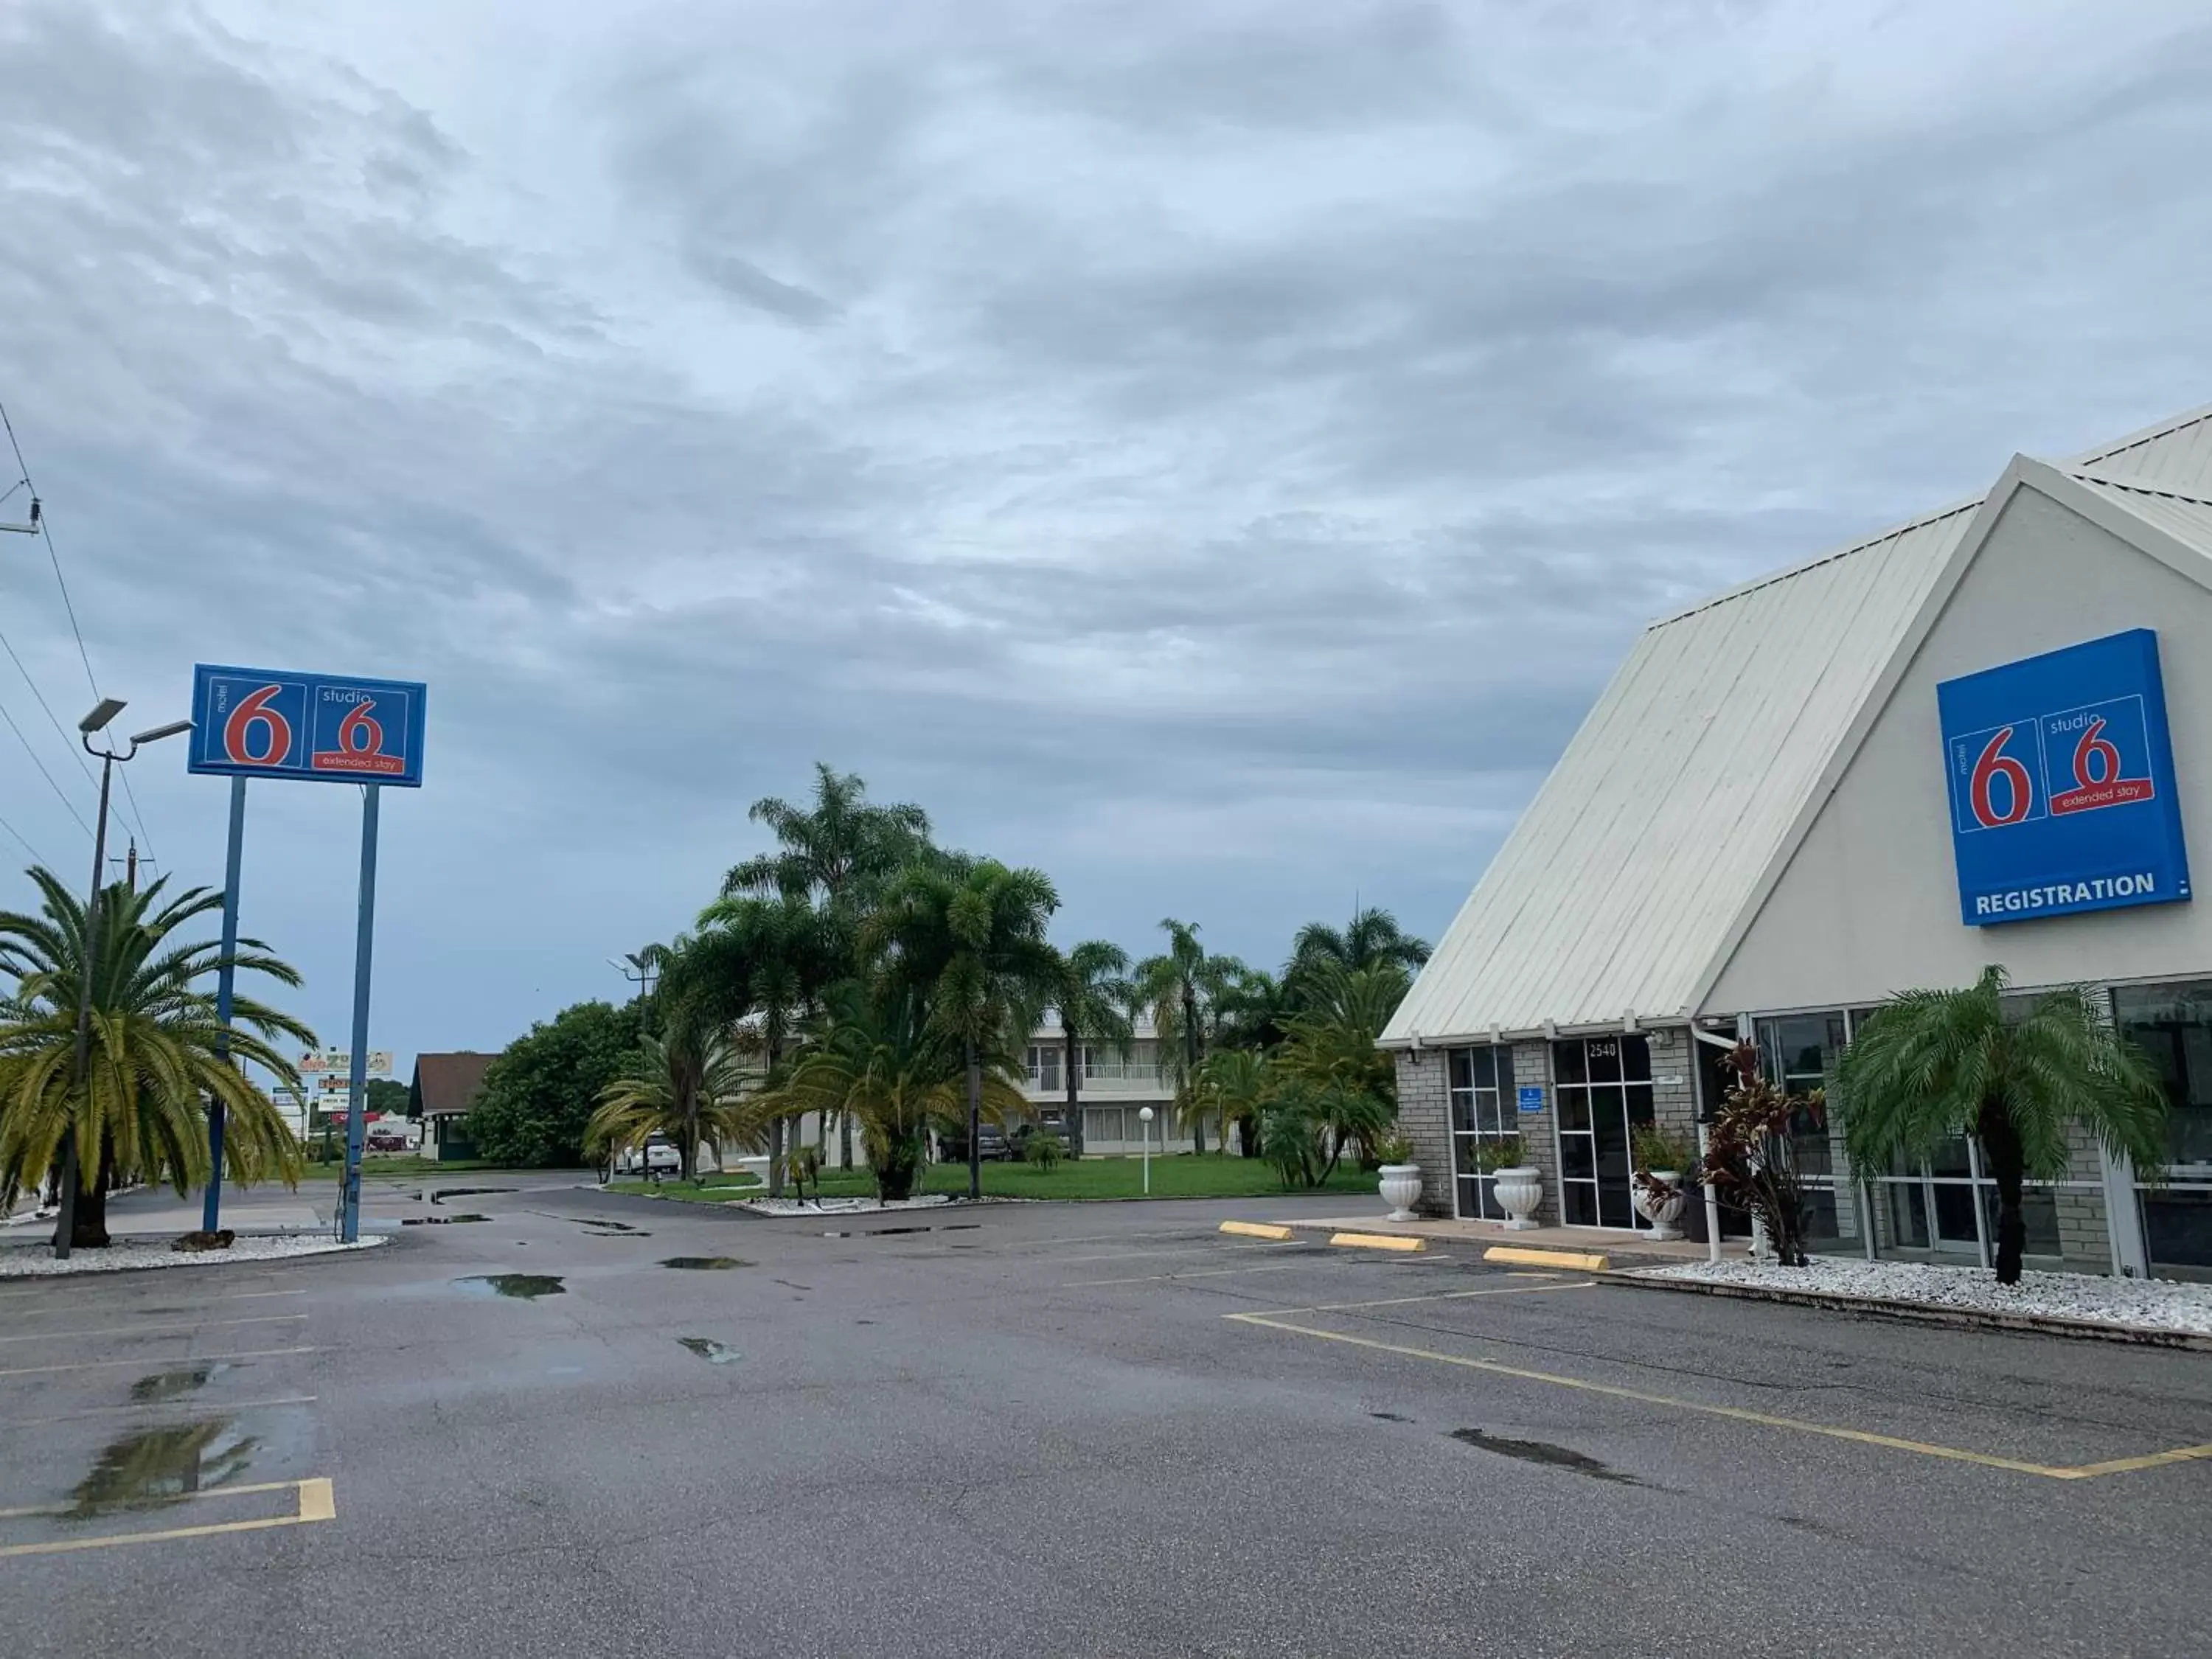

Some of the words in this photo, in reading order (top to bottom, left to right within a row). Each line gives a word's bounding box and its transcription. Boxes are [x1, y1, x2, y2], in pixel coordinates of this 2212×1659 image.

[216, 685, 228, 713] motel
[322, 689, 372, 703] studio
[223, 684, 292, 766] 6
[338, 700, 383, 754] 6
[2051, 712, 2101, 734] studio
[322, 757, 372, 768] extended
[374, 759, 397, 771] stay
[2073, 719, 2121, 787] 6
[1969, 726, 2033, 829] 6
[2062, 788, 2114, 808] extended
[2117, 785, 2140, 798] stay
[1975, 873, 2155, 915] REGISTRATION
[1590, 1043, 1615, 1057] 2540
